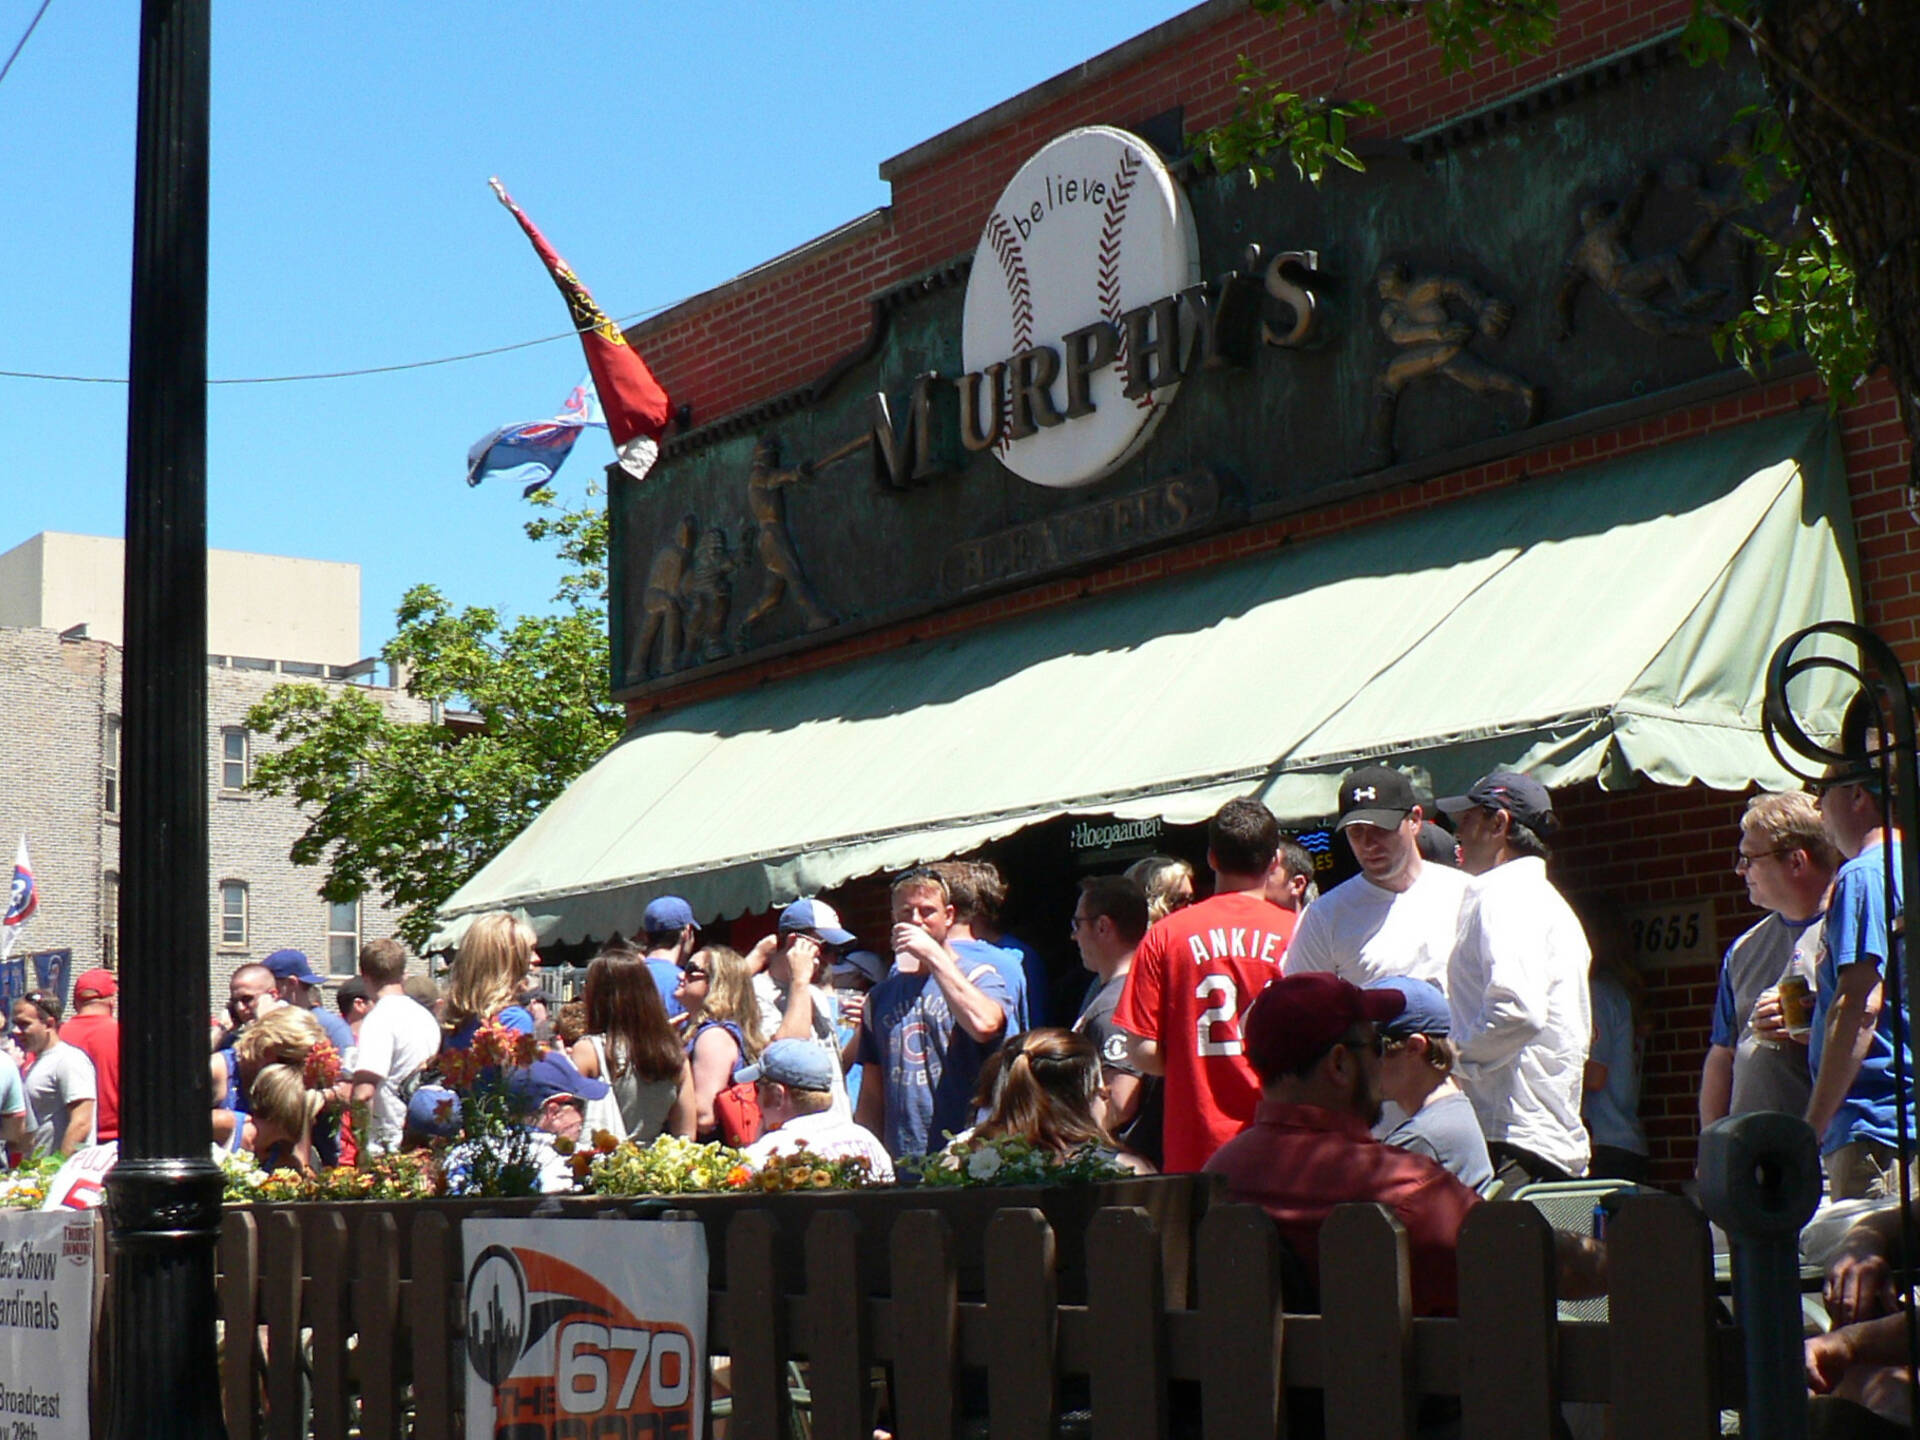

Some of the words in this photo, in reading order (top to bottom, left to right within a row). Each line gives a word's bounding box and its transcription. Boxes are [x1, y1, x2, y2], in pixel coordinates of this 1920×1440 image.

[1013, 175, 1105, 240] believe
[872, 243, 1318, 488] MURPHY'S
[1076, 817, 1161, 849] Hoegaarden
[1188, 927, 1287, 965] ANKIE
[1196, 974, 1262, 1057] 2
[17, 1240, 57, 1280] Show
[559, 1321, 691, 1414] 670
[499, 1386, 556, 1416] THE
